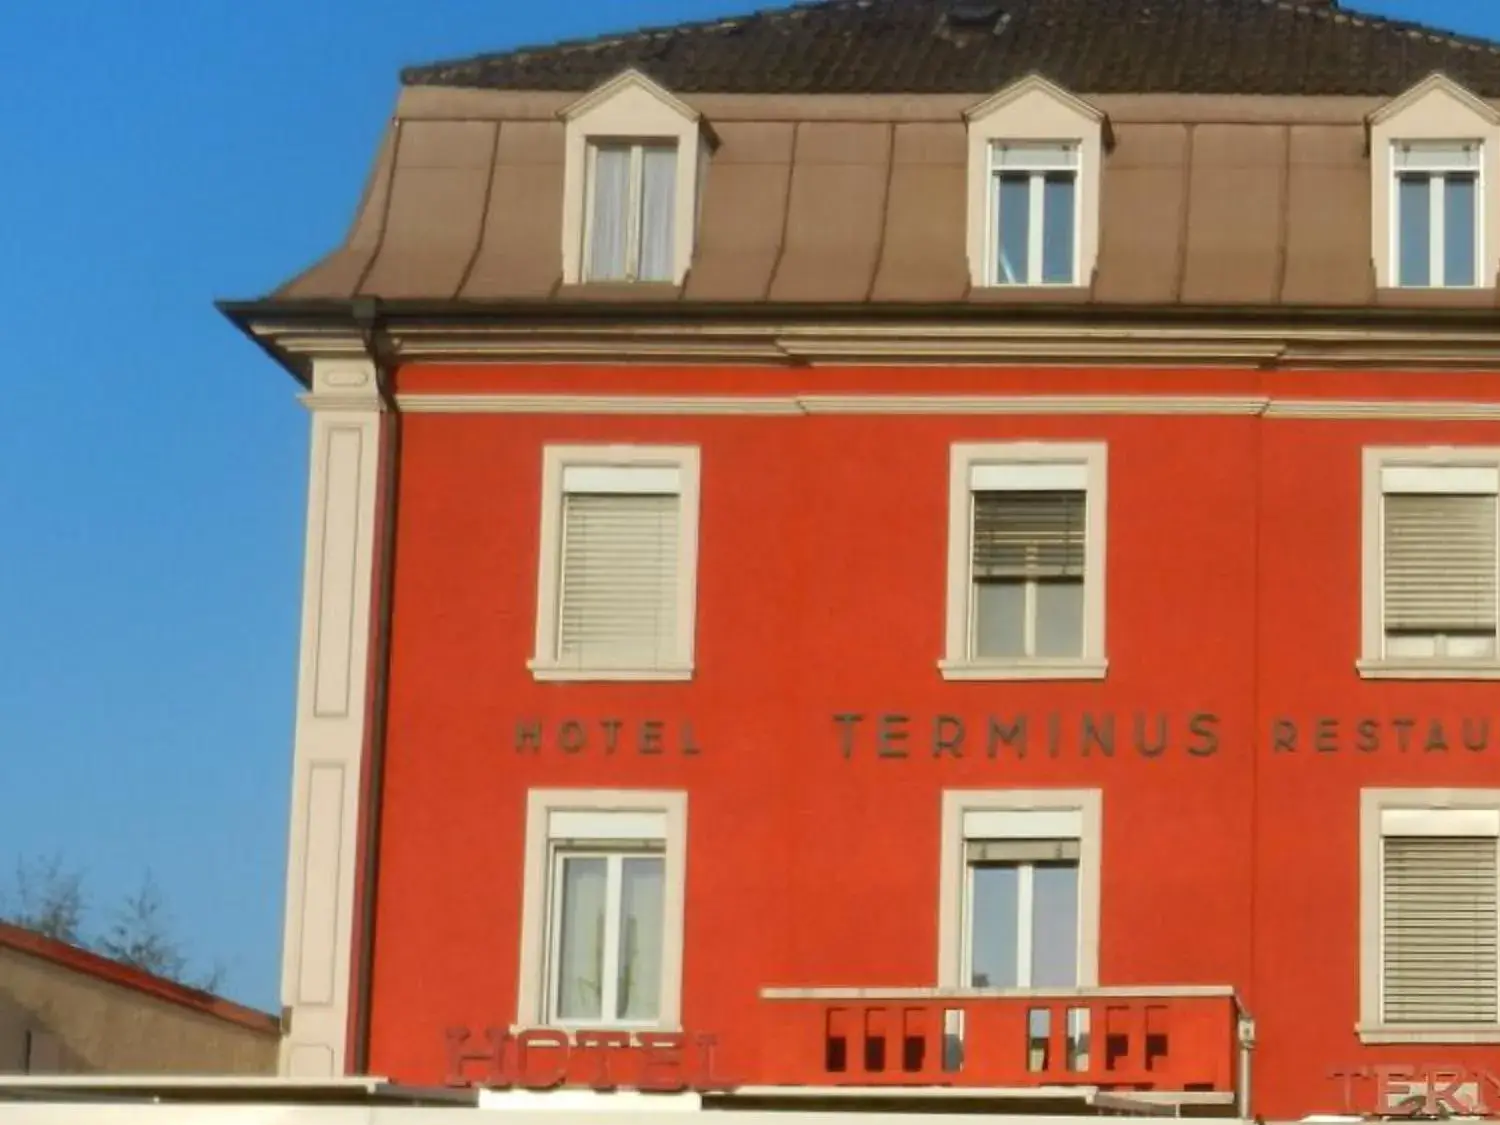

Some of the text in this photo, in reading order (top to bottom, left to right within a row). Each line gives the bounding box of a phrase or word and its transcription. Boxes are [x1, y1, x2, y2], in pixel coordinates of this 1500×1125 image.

[513, 717, 702, 757] HOTEL
[831, 714, 1222, 760] TERMINUS
[444, 1026, 746, 1094] HOTEL
